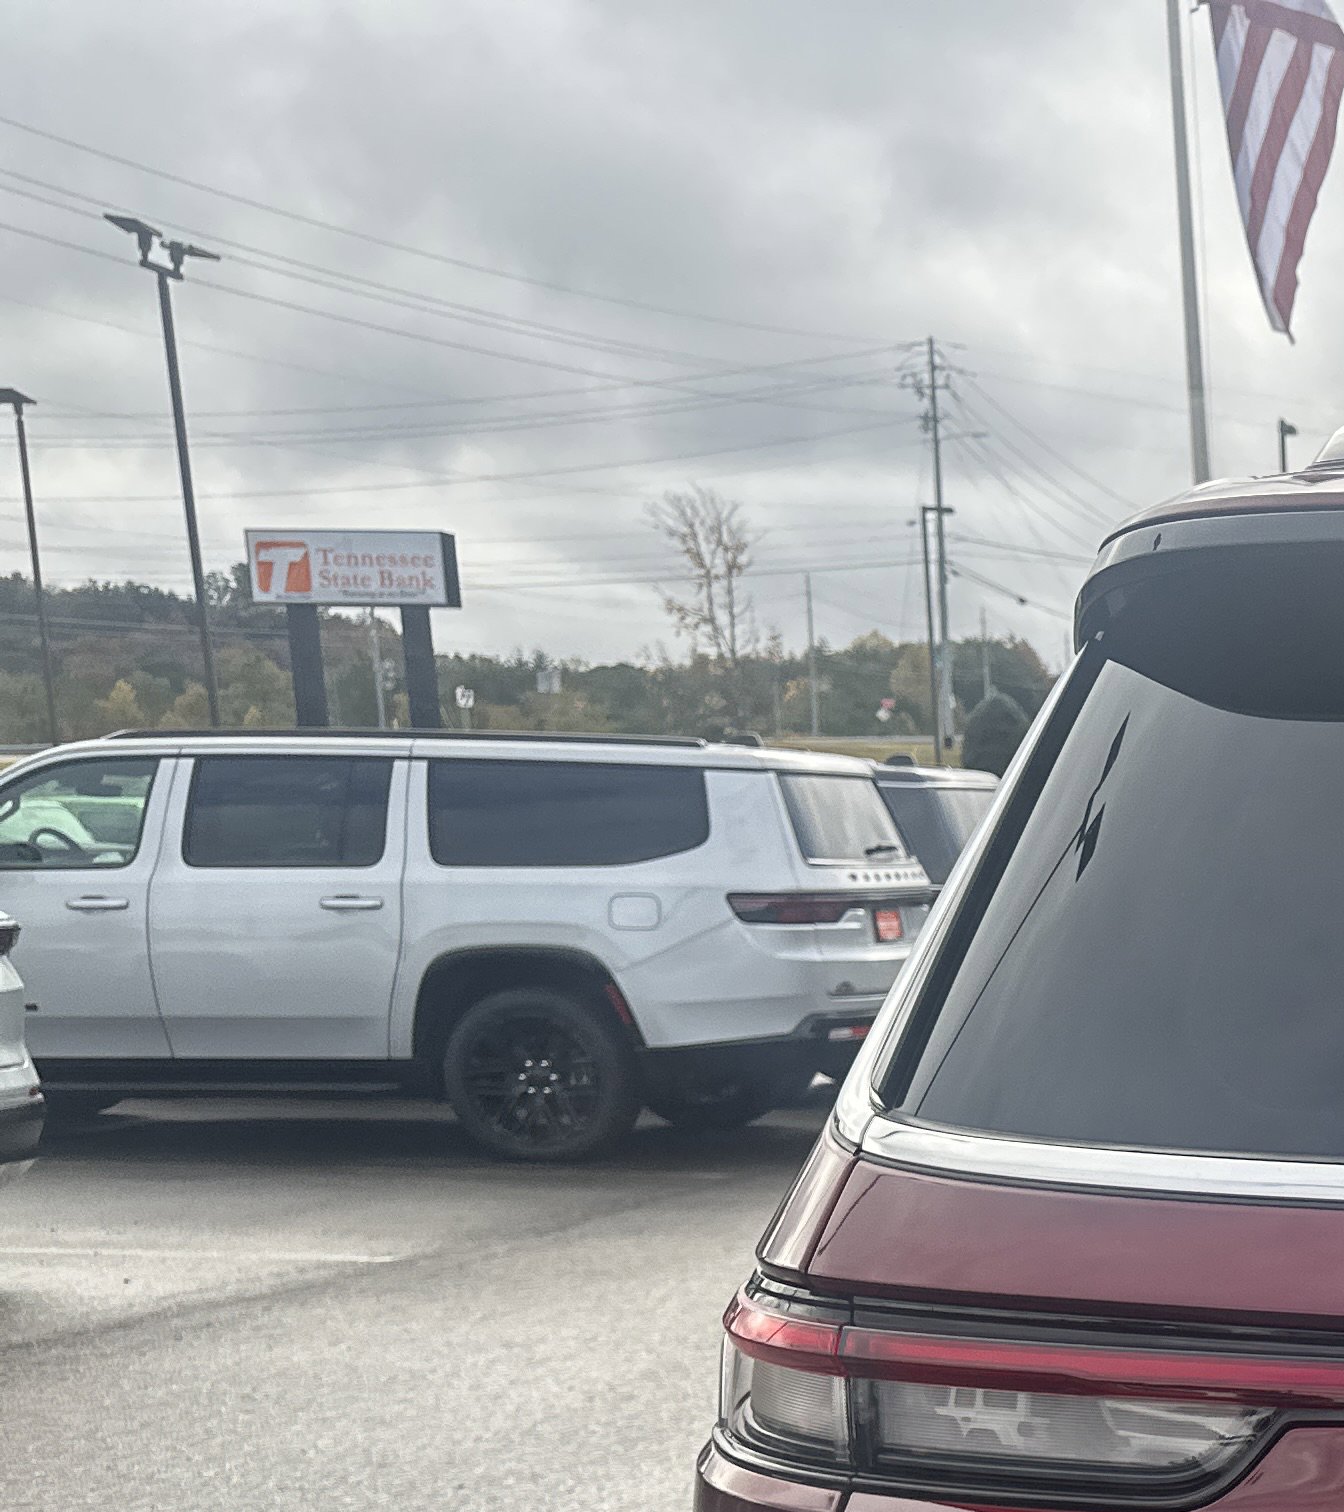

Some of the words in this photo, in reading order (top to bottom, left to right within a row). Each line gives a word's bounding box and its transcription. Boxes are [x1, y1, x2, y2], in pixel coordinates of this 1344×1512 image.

[316, 547, 435, 568] Tennessee
[319, 568, 371, 588] State
[379, 569, 436, 590] Bank
